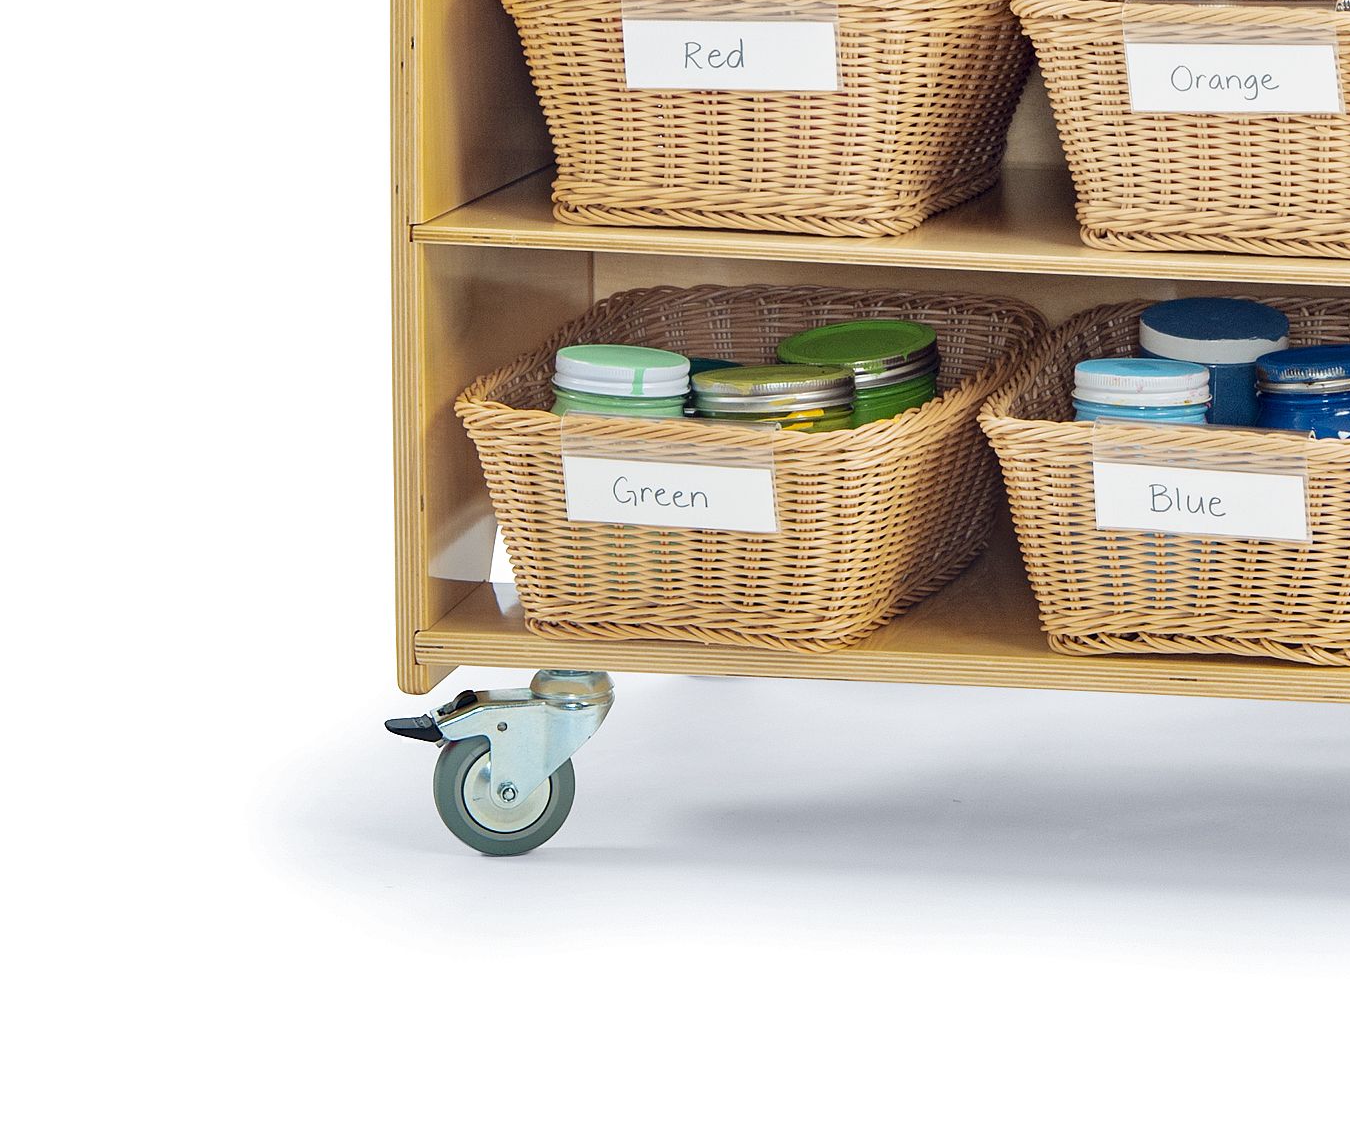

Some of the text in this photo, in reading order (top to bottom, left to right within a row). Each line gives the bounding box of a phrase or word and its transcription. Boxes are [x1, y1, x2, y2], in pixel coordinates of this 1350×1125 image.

[684, 38, 744, 70] Red
[1170, 65, 1280, 100] Orange
[613, 476, 708, 508] Green
[1149, 483, 1226, 517] Blue
